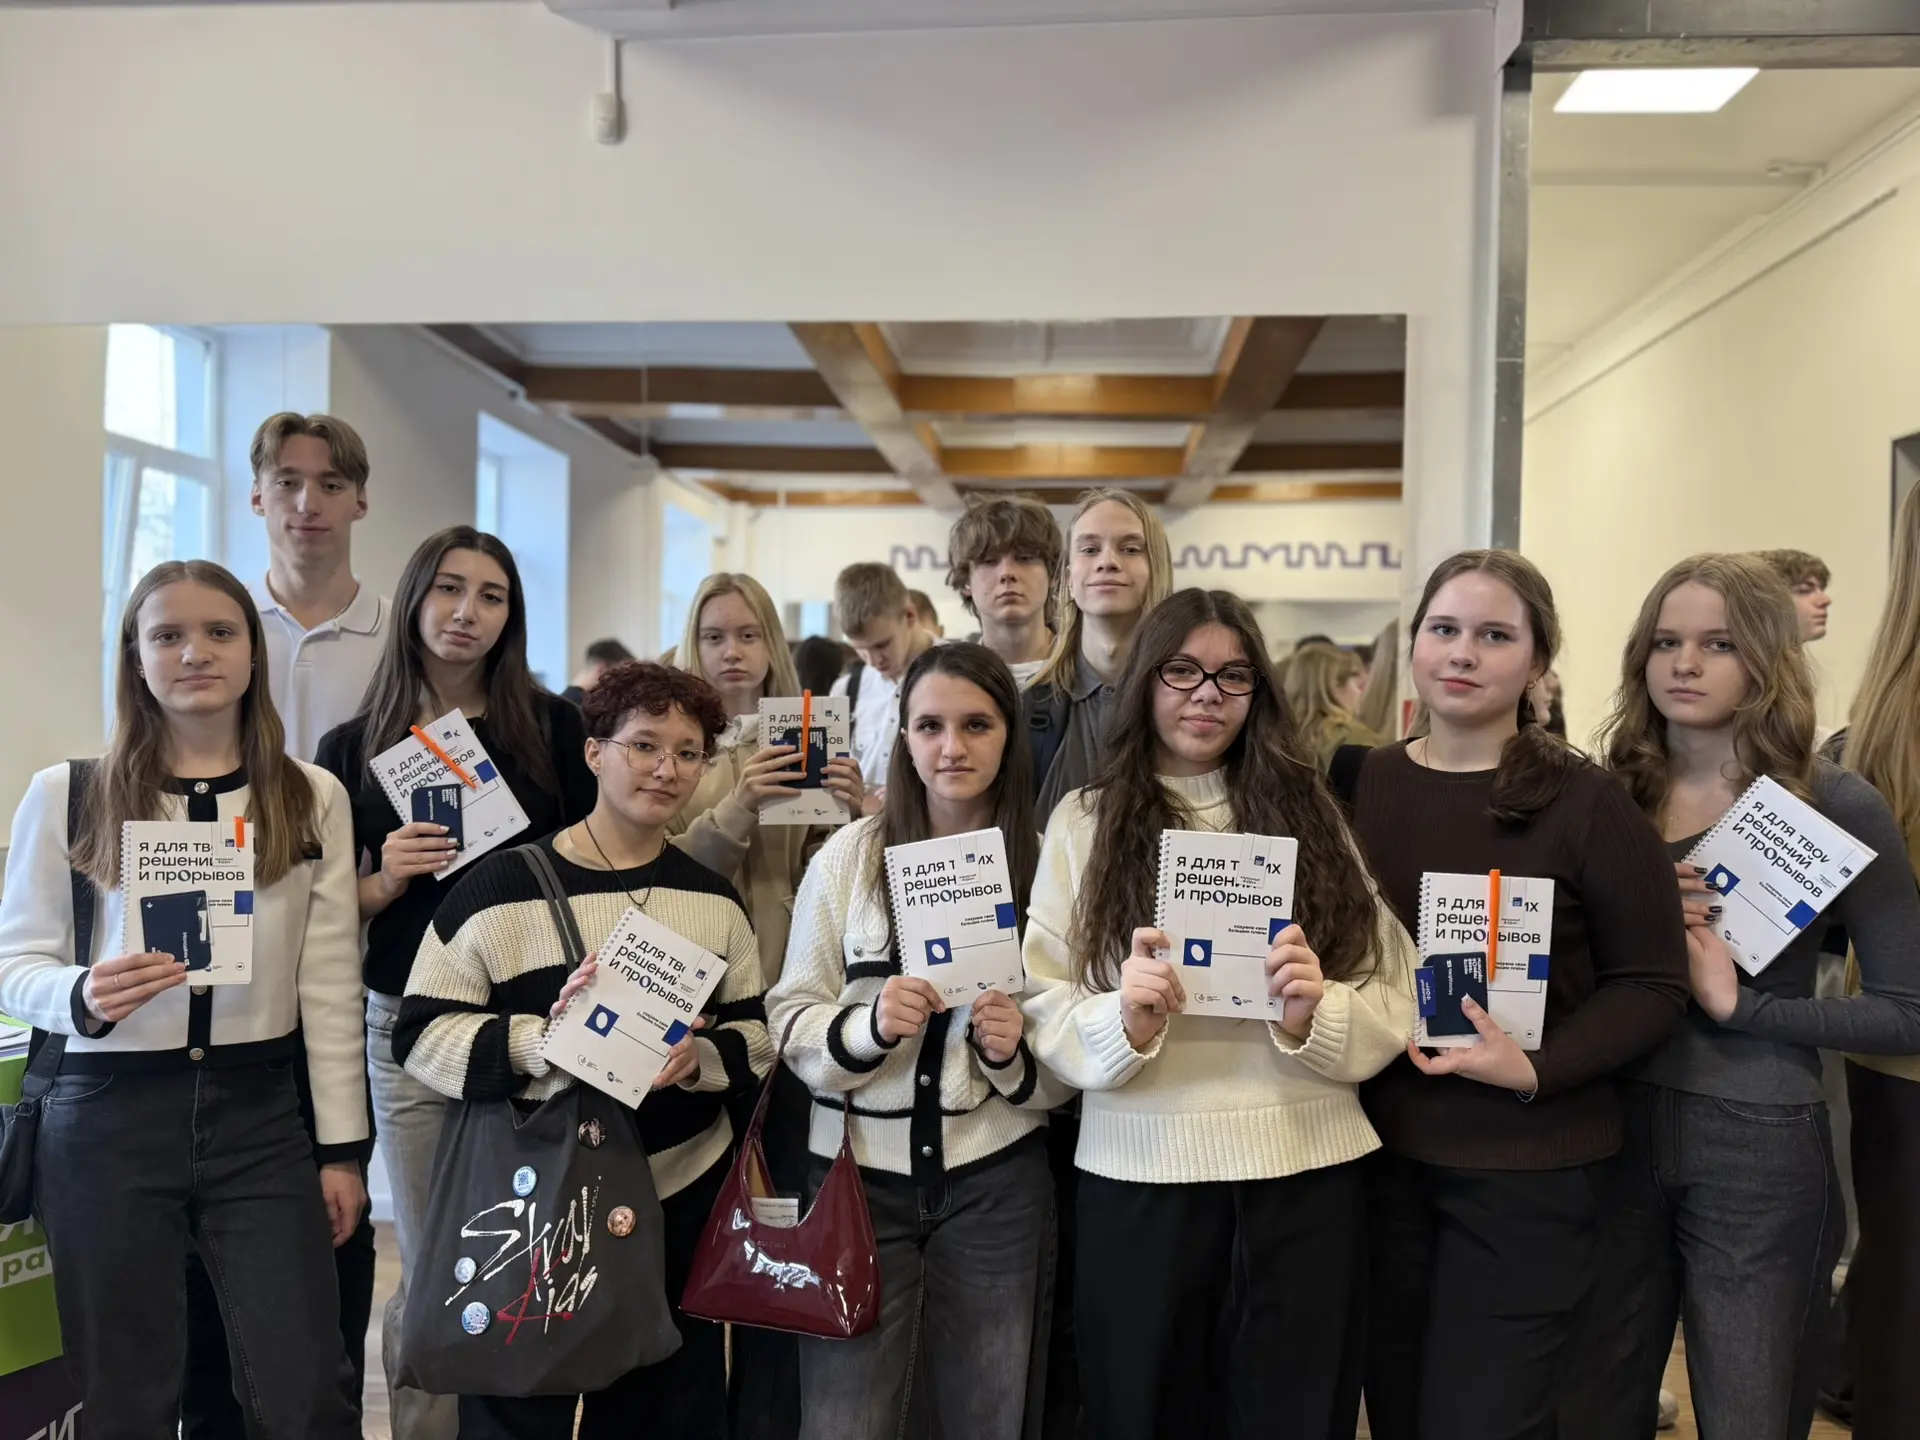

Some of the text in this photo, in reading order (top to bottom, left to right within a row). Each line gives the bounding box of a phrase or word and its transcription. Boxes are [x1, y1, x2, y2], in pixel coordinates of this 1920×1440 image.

[769, 714, 776, 722] я
[779, 714, 802, 723] для
[388, 754, 424, 778] я для
[400, 789, 410, 799] и
[1752, 801, 1764, 813] я
[1762, 812, 1796, 837] для
[1732, 823, 1745, 835] и
[1740, 812, 1813, 870] решений
[139, 842, 149, 852] я
[154, 843, 188, 854] для
[902, 866, 911, 877] я
[915, 861, 945, 877] для
[1176, 856, 1187, 867] я
[1190, 857, 1226, 871] для
[139, 871, 149, 881] и
[1174, 888, 1185, 900] и
[906, 896, 916, 907] и
[1437, 897, 1485, 911] я для
[1435, 928, 1446, 939] и
[626, 933, 666, 962] я для
[608, 957, 620, 970] и
